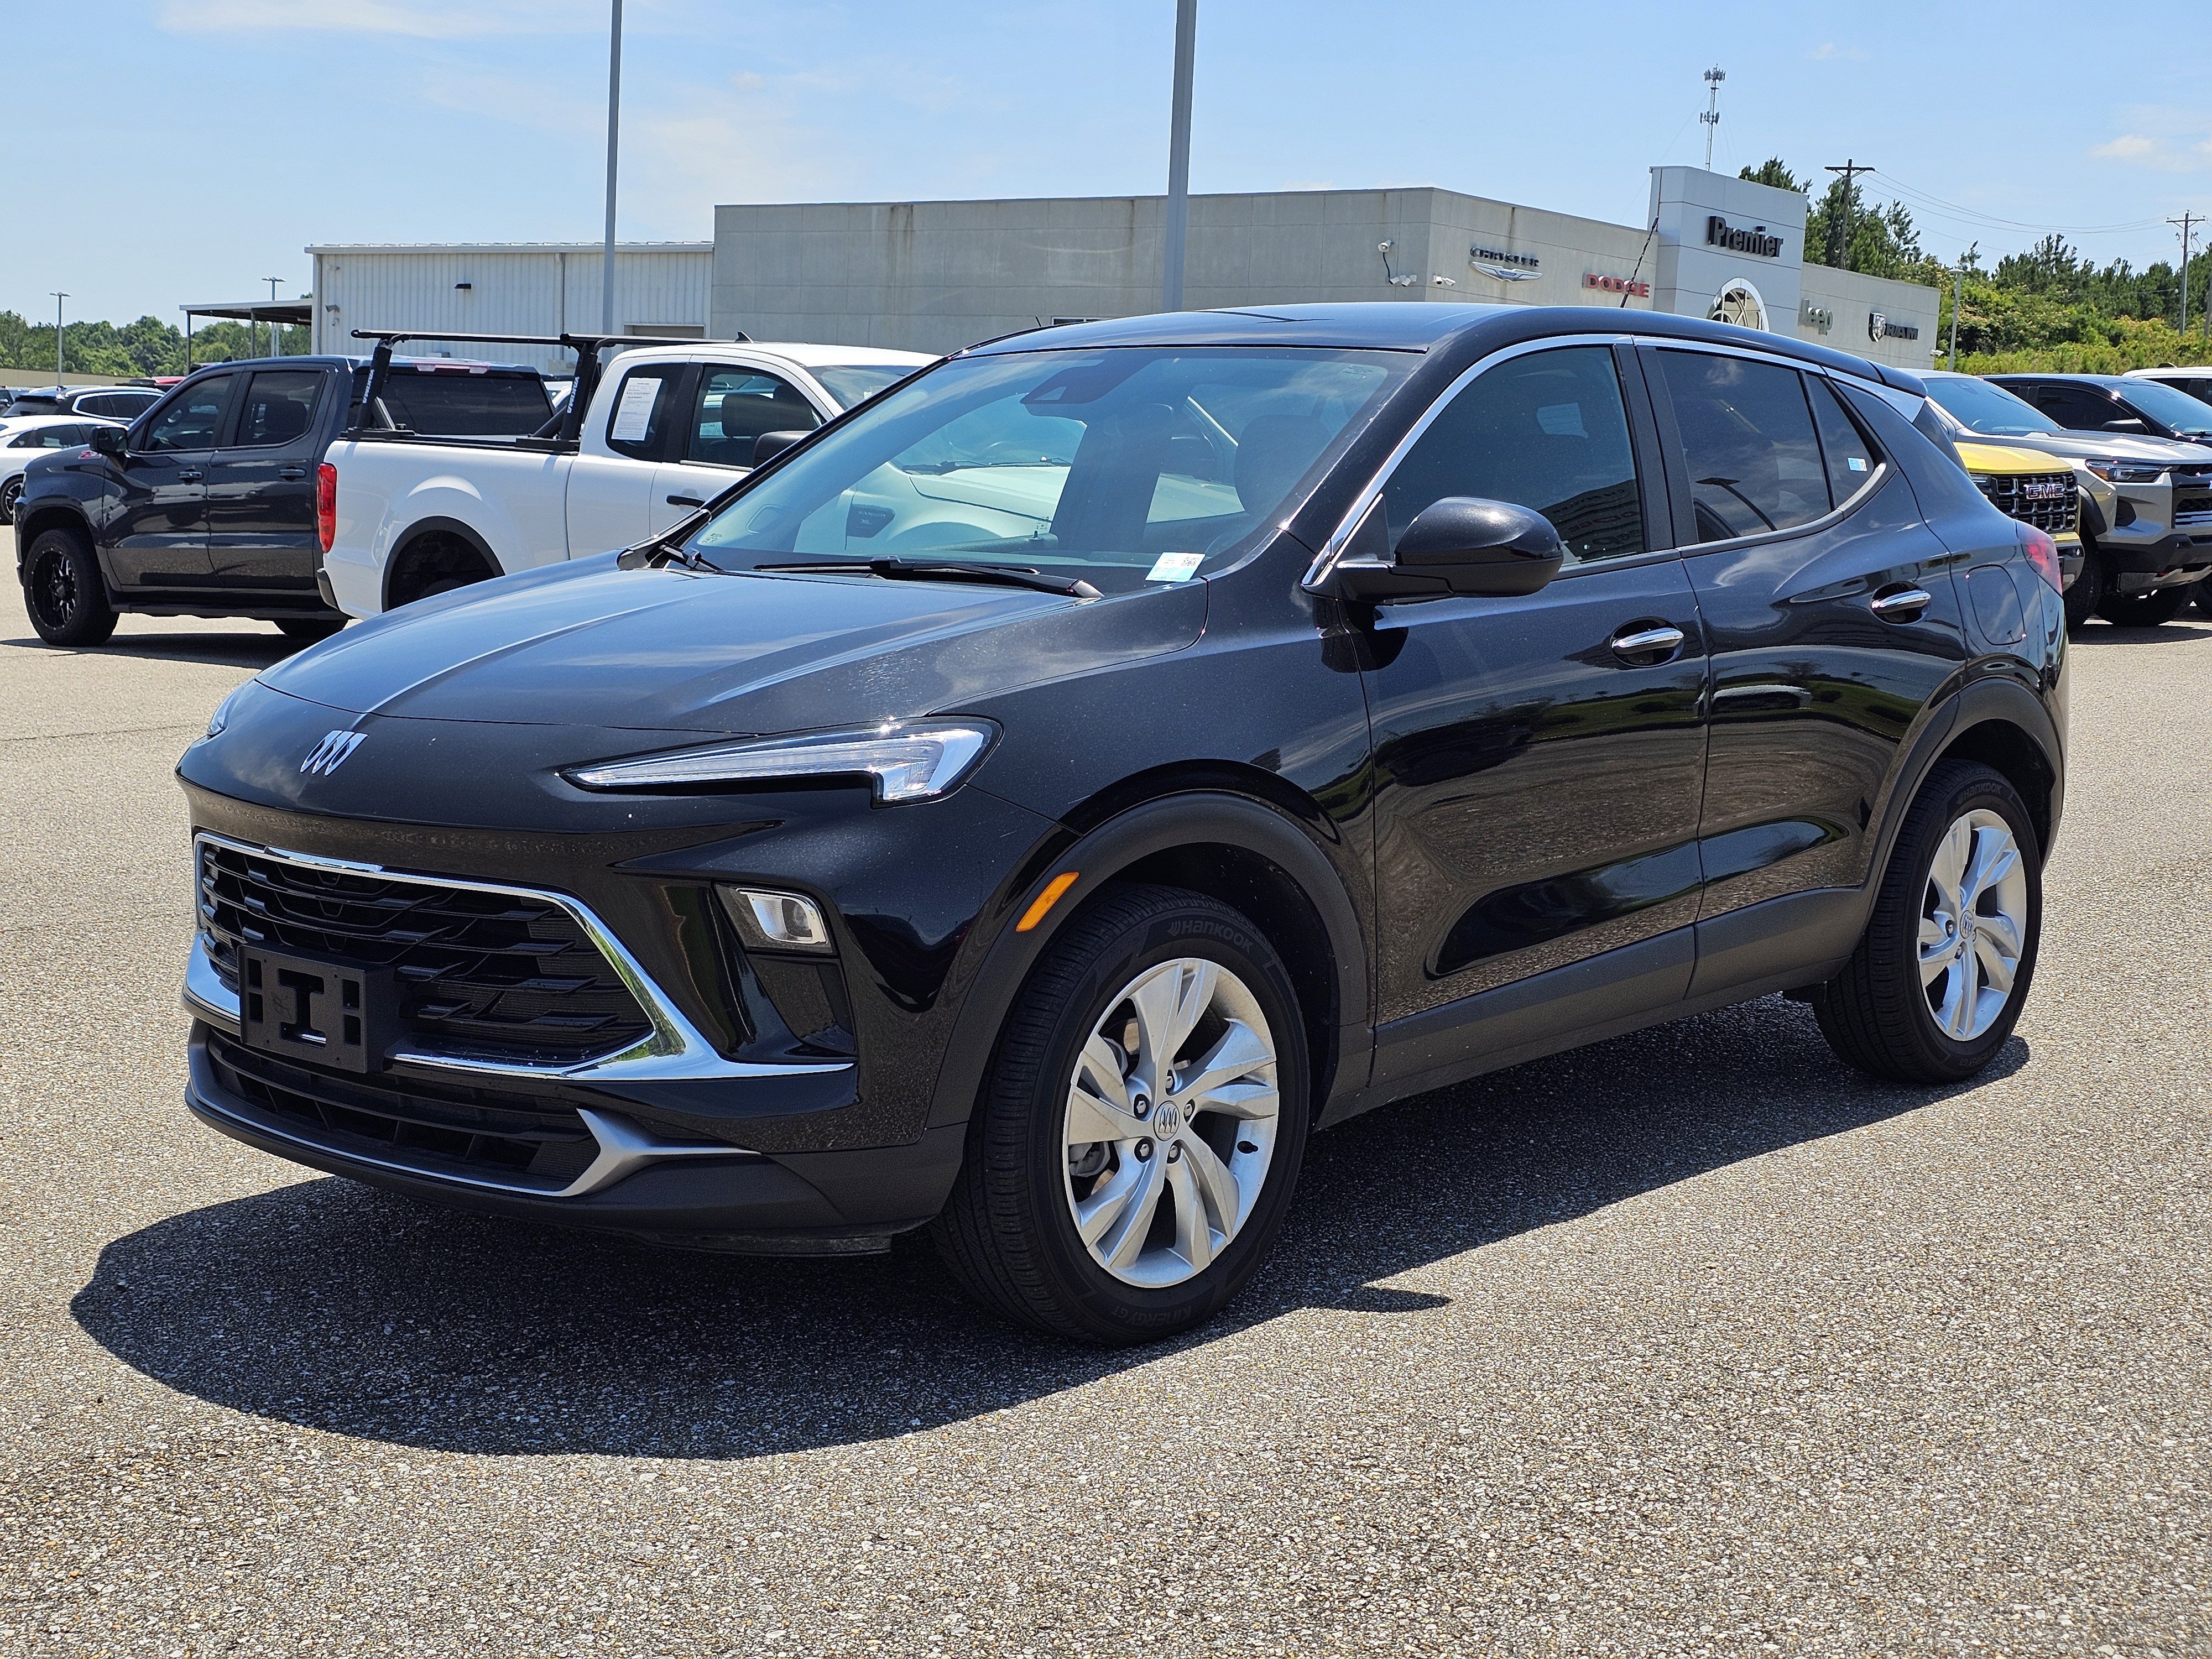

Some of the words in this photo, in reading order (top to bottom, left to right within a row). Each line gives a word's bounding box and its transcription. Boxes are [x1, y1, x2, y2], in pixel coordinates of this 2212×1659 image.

[1708, 216, 1784, 257] Premier
[1470, 248, 1540, 267] CHRYSLER
[1583, 273, 1650, 298] DODGE
[1798, 299, 1833, 336] Jeep
[1884, 323, 1918, 340] RAM
[2023, 483, 2064, 500] GMC
